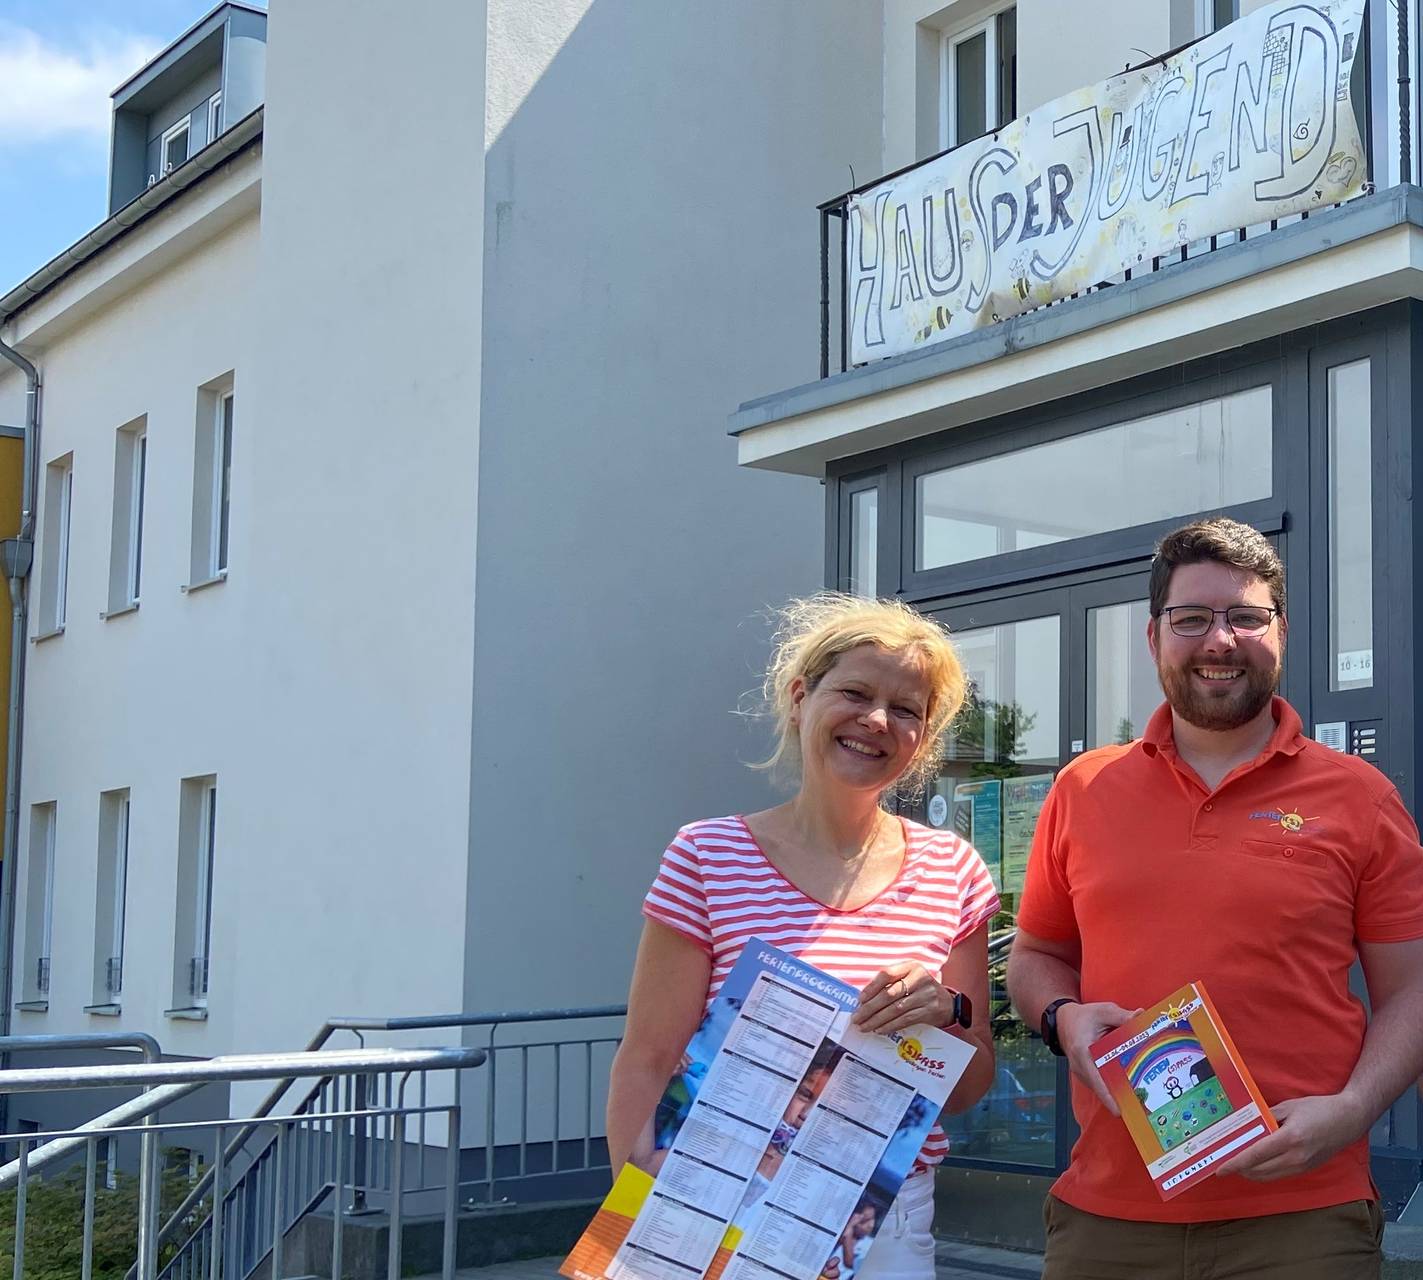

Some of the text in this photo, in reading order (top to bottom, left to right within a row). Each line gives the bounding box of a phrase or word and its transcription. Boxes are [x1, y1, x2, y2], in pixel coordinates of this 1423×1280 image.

[850, 5, 1338, 348] HAUS DER JUGEND
